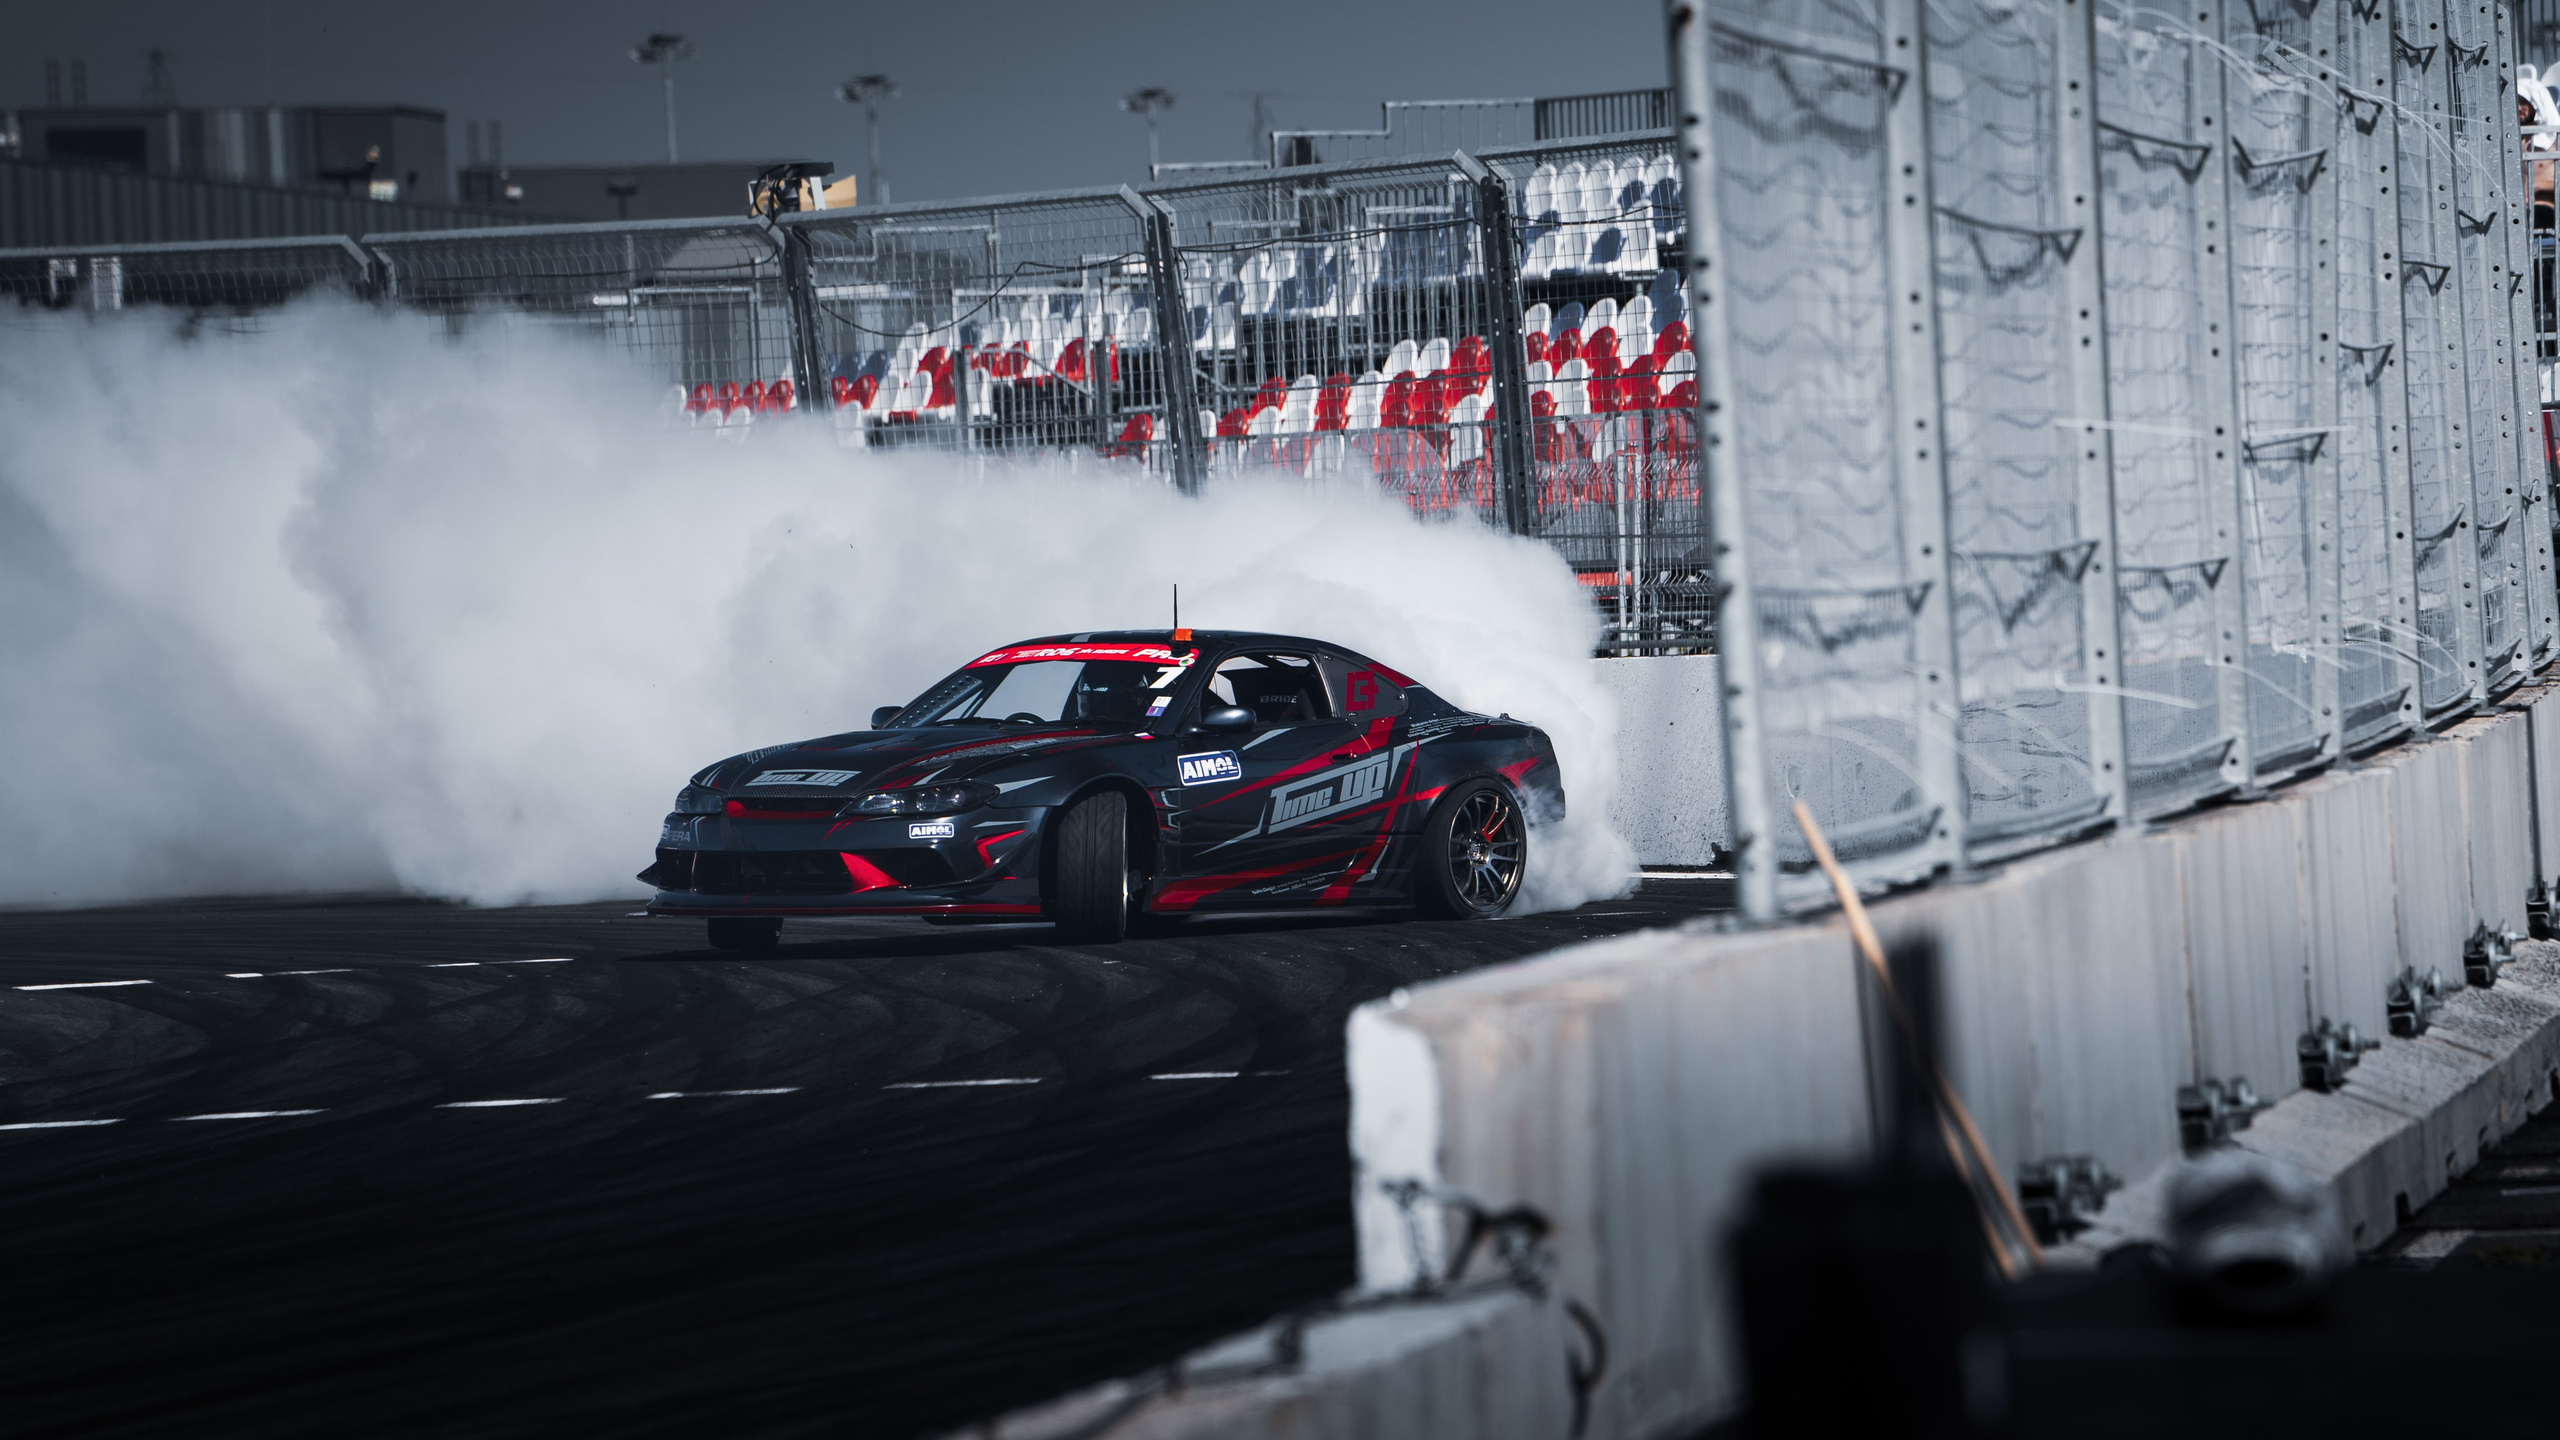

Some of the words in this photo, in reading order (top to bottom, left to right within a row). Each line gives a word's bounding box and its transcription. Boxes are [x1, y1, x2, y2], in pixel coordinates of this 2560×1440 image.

[1149, 666, 1187, 689] 7
[1259, 694, 1298, 704] BRIDE
[1183, 756, 1239, 780] AIMOL
[911, 825, 952, 836] AIMOL
